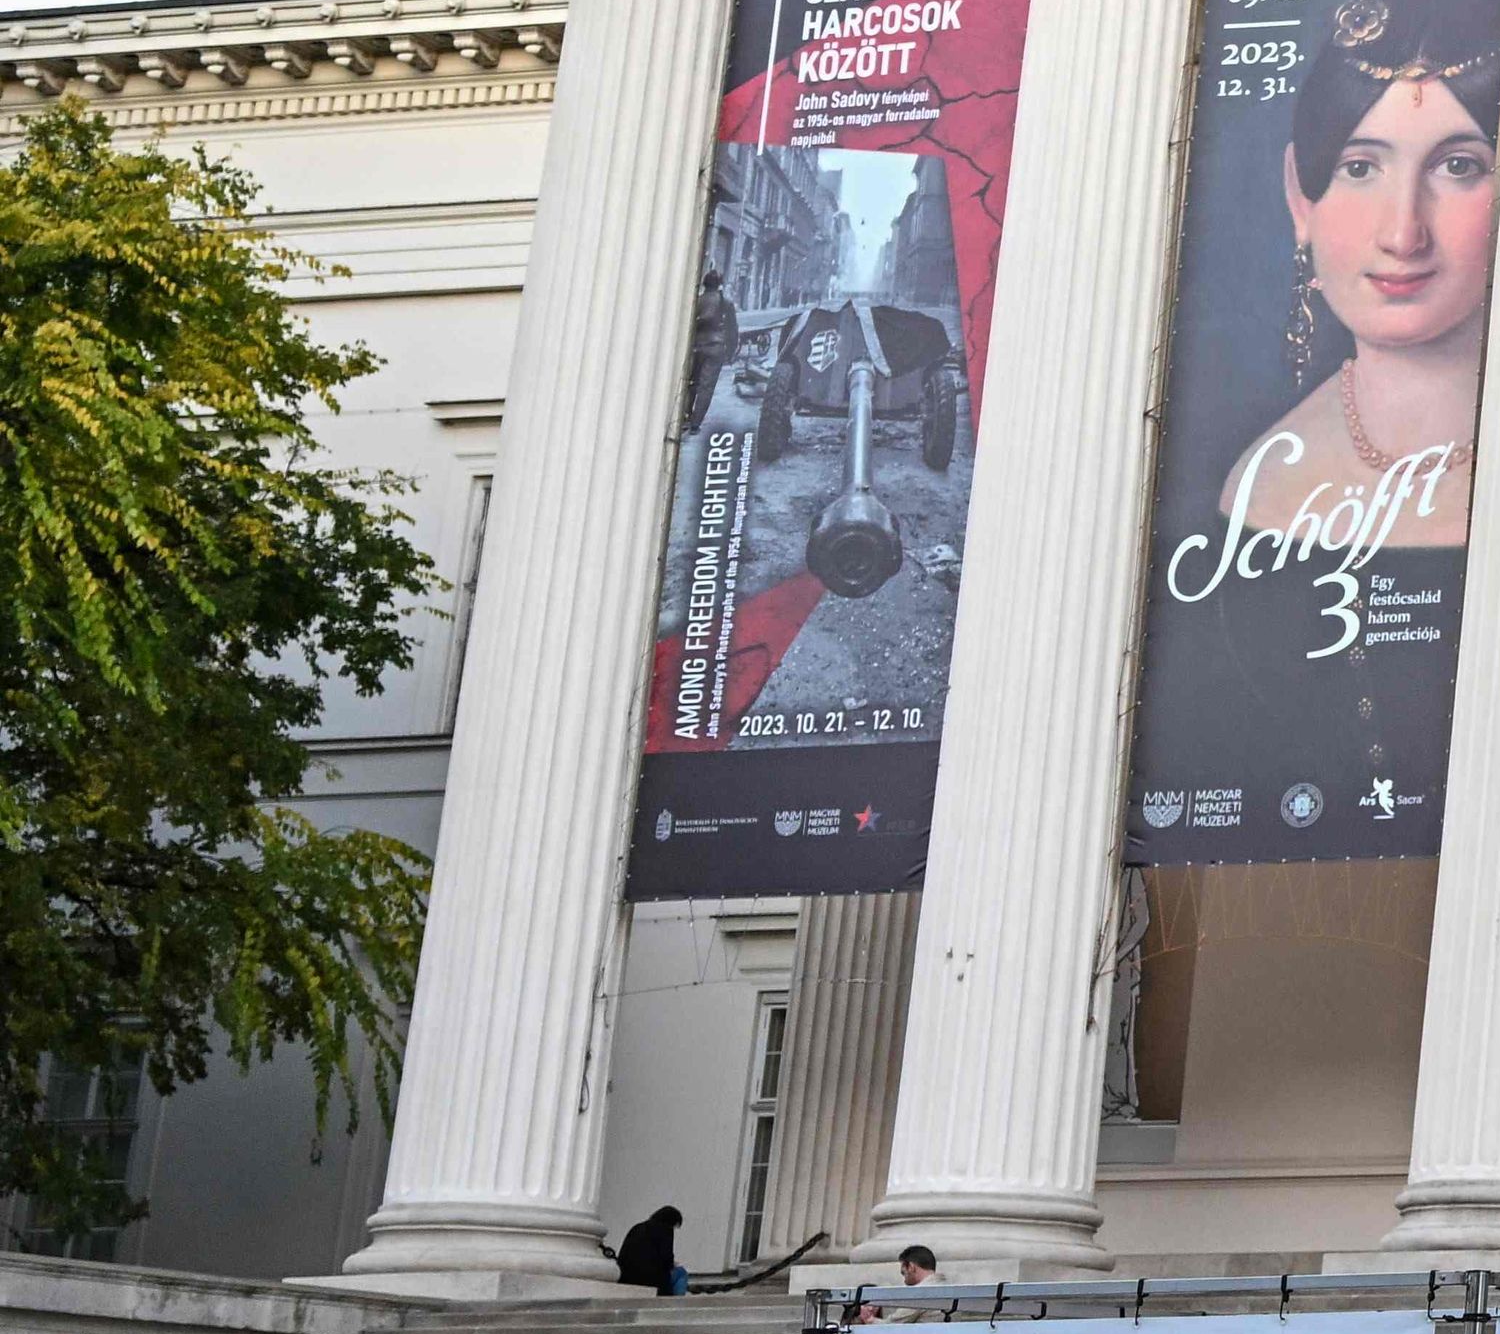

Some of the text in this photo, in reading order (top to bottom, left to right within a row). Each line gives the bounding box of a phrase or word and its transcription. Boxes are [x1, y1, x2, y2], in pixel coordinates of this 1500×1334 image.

[802, 0, 963, 41] HARCOSOK
[798, 38, 917, 84] KÖZÖTT
[1221, 40, 1305, 72] 2023.
[1216, 76, 1297, 102] 12. 31.
[795, 92, 828, 111] John
[831, 90, 880, 110] Sadovy
[793, 107, 940, 129] az 1956-os magyar forradalom
[791, 130, 836, 148] napjaiból
[736, 432, 754, 482] Revolution
[730, 482, 747, 535] Hungarian
[1168, 431, 1455, 603] Schöfft
[727, 535, 741, 559] 1956
[726, 560, 738, 576] the
[674, 432, 734, 740] AMONG FREEDOM FIGHTERS
[724, 577, 736, 590] of
[1370, 575, 1395, 593] Egy
[1368, 589, 1442, 608] festőcsalád
[715, 590, 734, 660] Photographs
[1306, 571, 1361, 660] 3
[1367, 609, 1411, 625] három
[1365, 625, 1441, 646] generációja
[706, 711, 719, 740] John
[739, 708, 925, 737] 2023. 10. 21. 12. 10.
[1143, 790, 1185, 804] MNM
[1194, 788, 1242, 801] MAGYAR
[1359, 795, 1377, 807] Ars
[1194, 801, 1242, 814] NEMZETI
[1192, 813, 1240, 827] MÚZEUM
